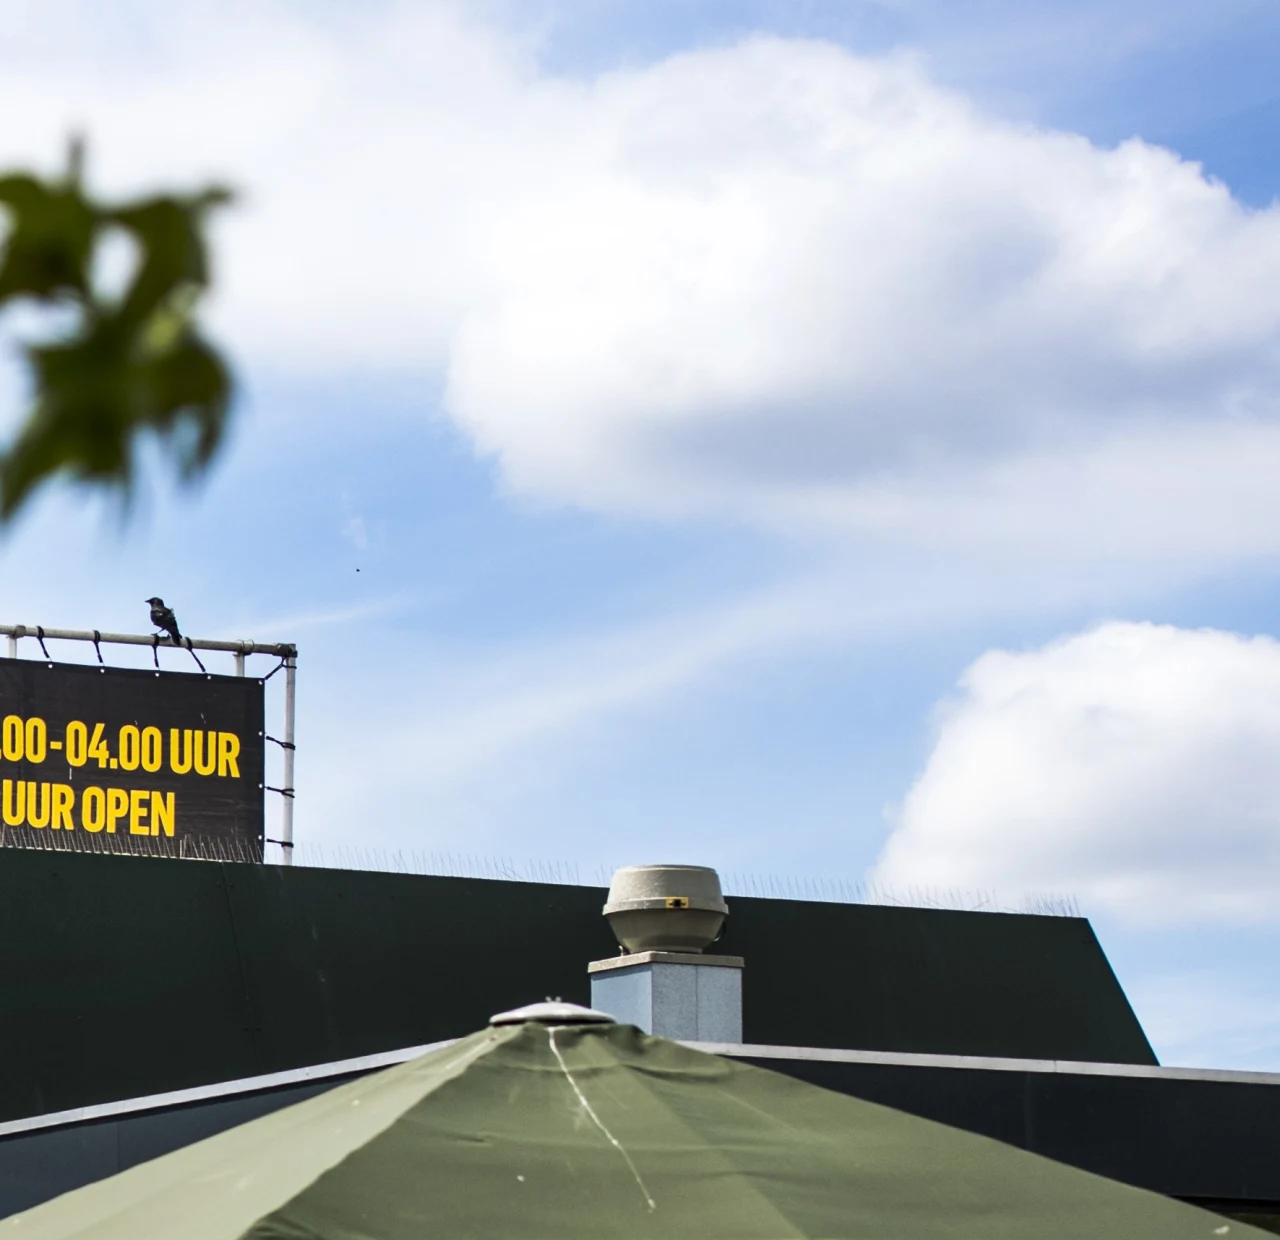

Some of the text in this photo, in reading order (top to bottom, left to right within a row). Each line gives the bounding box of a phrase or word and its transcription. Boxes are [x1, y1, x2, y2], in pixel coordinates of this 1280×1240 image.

[170, 728, 240, 778] UUR
[2, 779, 75, 830] UUR
[81, 786, 175, 837] OPEN
